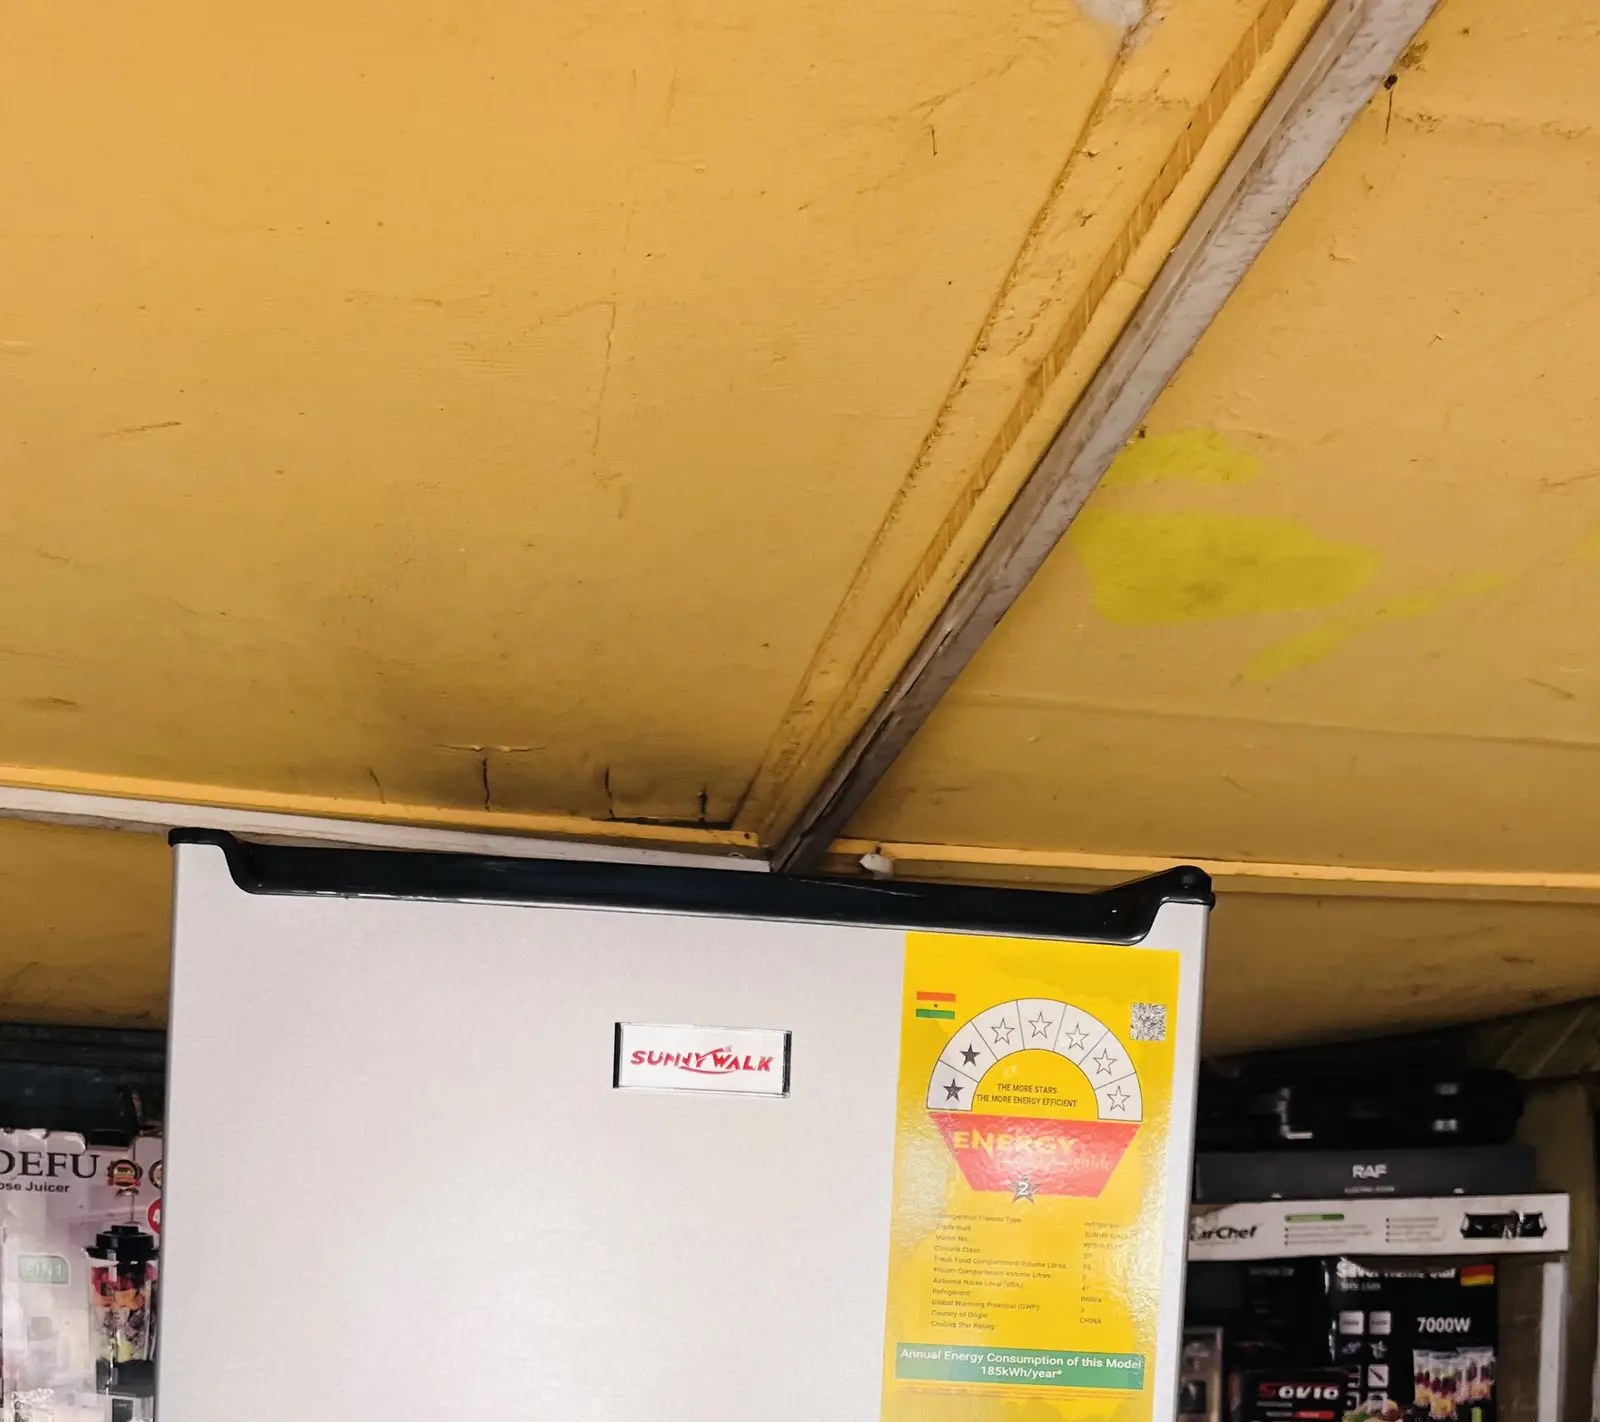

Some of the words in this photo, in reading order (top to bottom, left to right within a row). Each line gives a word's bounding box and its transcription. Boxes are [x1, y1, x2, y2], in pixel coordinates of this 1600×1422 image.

[997, 1083, 1011, 1091] THE
[1012, 1084, 1032, 1092] MORE
[1034, 1086, 1057, 1094] STARS
[976, 1094, 990, 1102] THE
[991, 1095, 1012, 1103] MORE
[1013, 1096, 1040, 1105] ENERGY
[1042, 1098, 1077, 1107] EFFICIENT
[953, 1130, 1079, 1156] ENERGY
[1352, 1164, 1388, 1179] RAF
[25, 1182, 70, 1193] Juicer
[1017, 1181, 1030, 1196] 2
[931, 1299, 954, 1307] Global
[955, 1300, 985, 1309] Warming
[931, 1310, 957, 1318] Country
[930, 1320, 957, 1329] Cooling
[1417, 1316, 1471, 1333] 7000W
[900, 1348, 941, 1360] Annual
[944, 1350, 983, 1364] Energy
[986, 1353, 1063, 1367] Consumption
[1066, 1356, 1079, 1366] of
[1081, 1357, 1103, 1368] this
